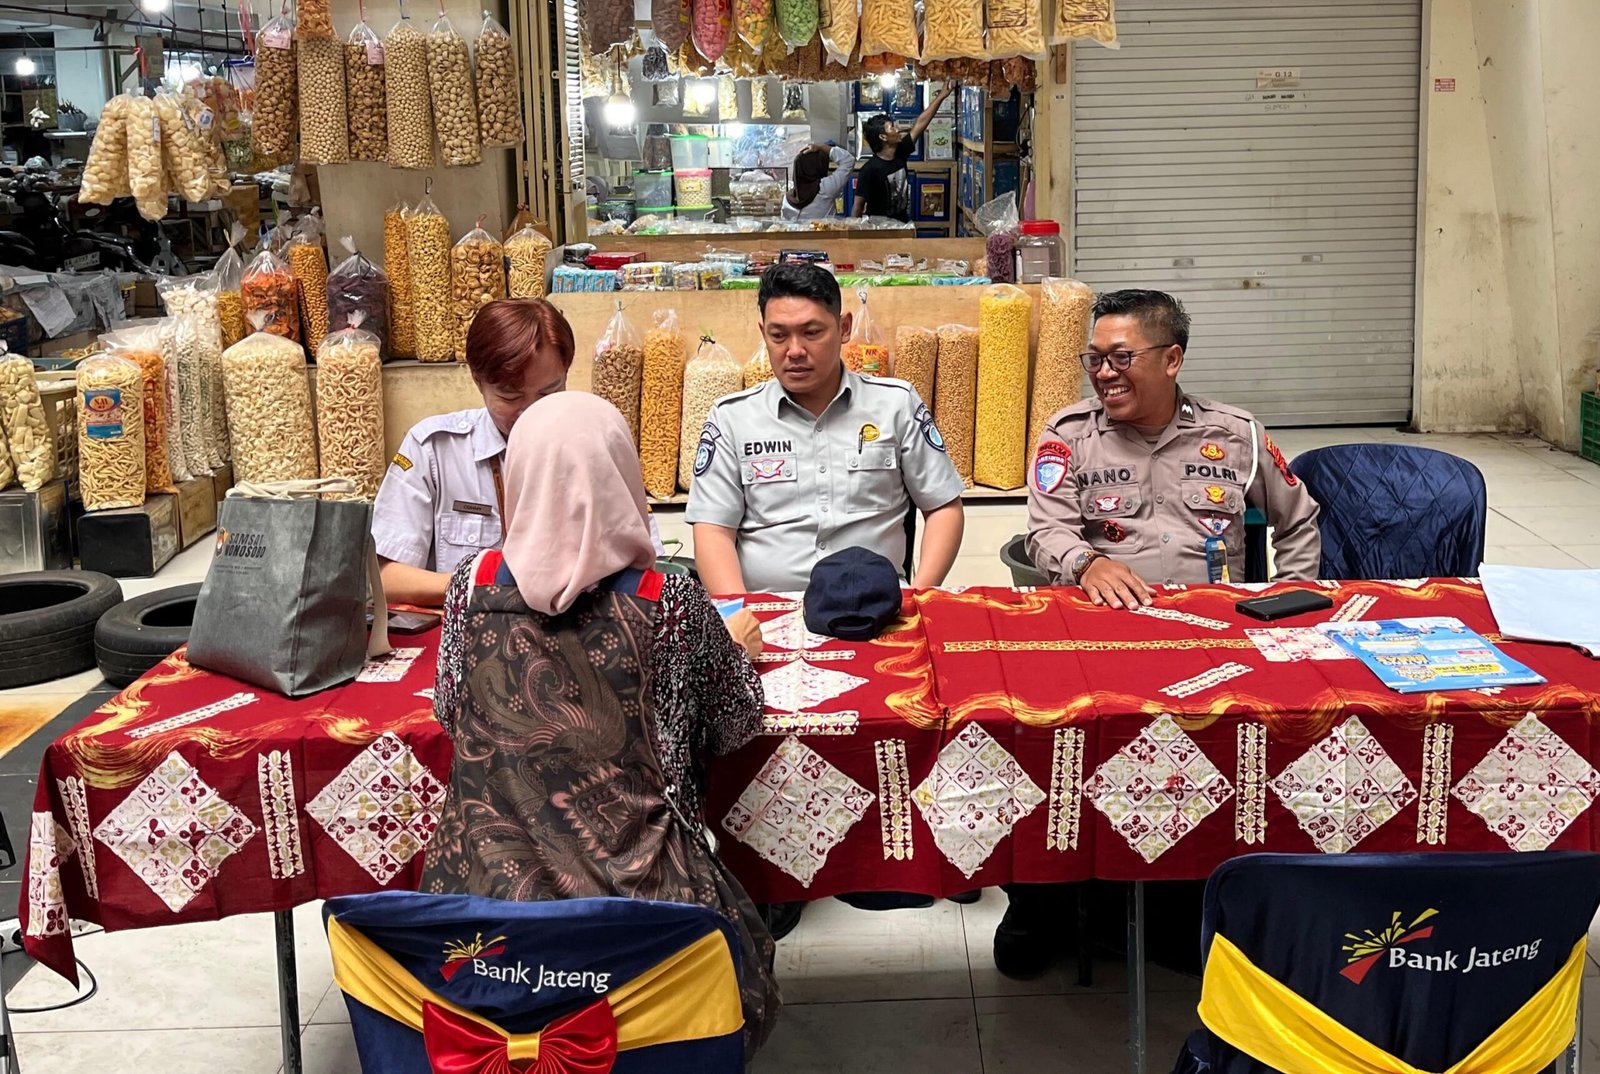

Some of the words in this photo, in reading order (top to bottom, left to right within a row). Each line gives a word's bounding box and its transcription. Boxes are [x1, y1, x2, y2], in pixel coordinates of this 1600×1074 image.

[744, 440, 792, 456] EDWIN
[1077, 468, 1130, 486] NANO
[1185, 464, 1238, 482] POLRI
[1389, 947, 1459, 972] Bank
[1462, 938, 1543, 974] Jateng
[473, 958, 531, 985] Bank
[532, 964, 612, 994] Jateng
